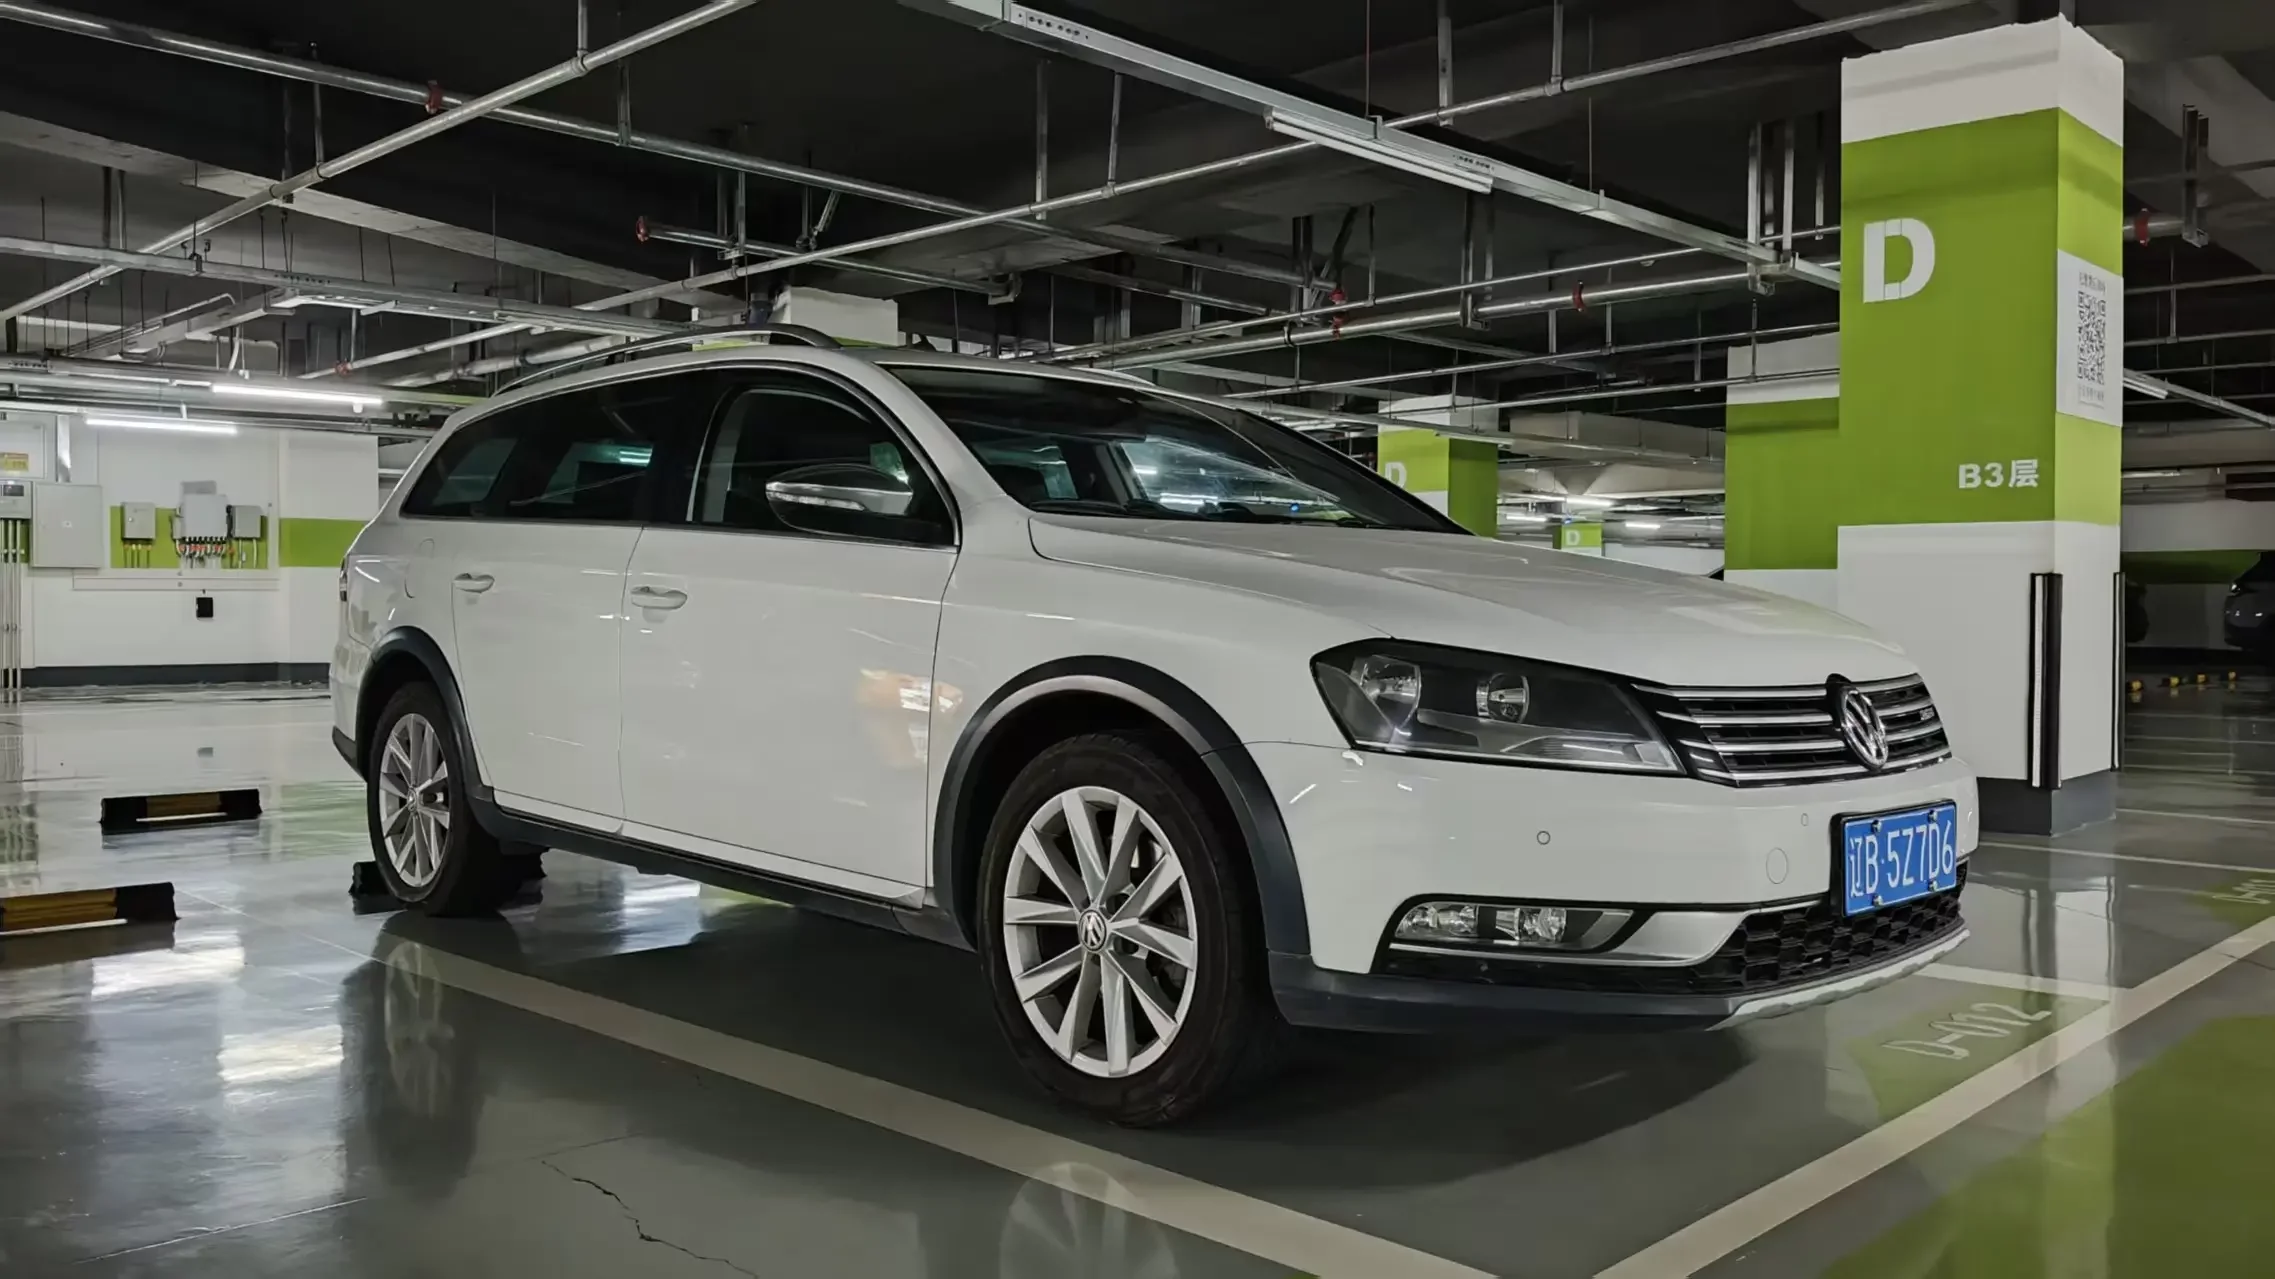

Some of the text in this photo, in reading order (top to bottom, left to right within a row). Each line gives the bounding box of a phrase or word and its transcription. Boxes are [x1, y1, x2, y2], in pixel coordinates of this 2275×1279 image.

[1863, 218, 1936, 304] D
[1385, 461, 1407, 488] D
[1958, 458, 2040, 489] B3层
[1565, 529, 1581, 546] D
[1880, 1002, 2053, 1061] D-012
